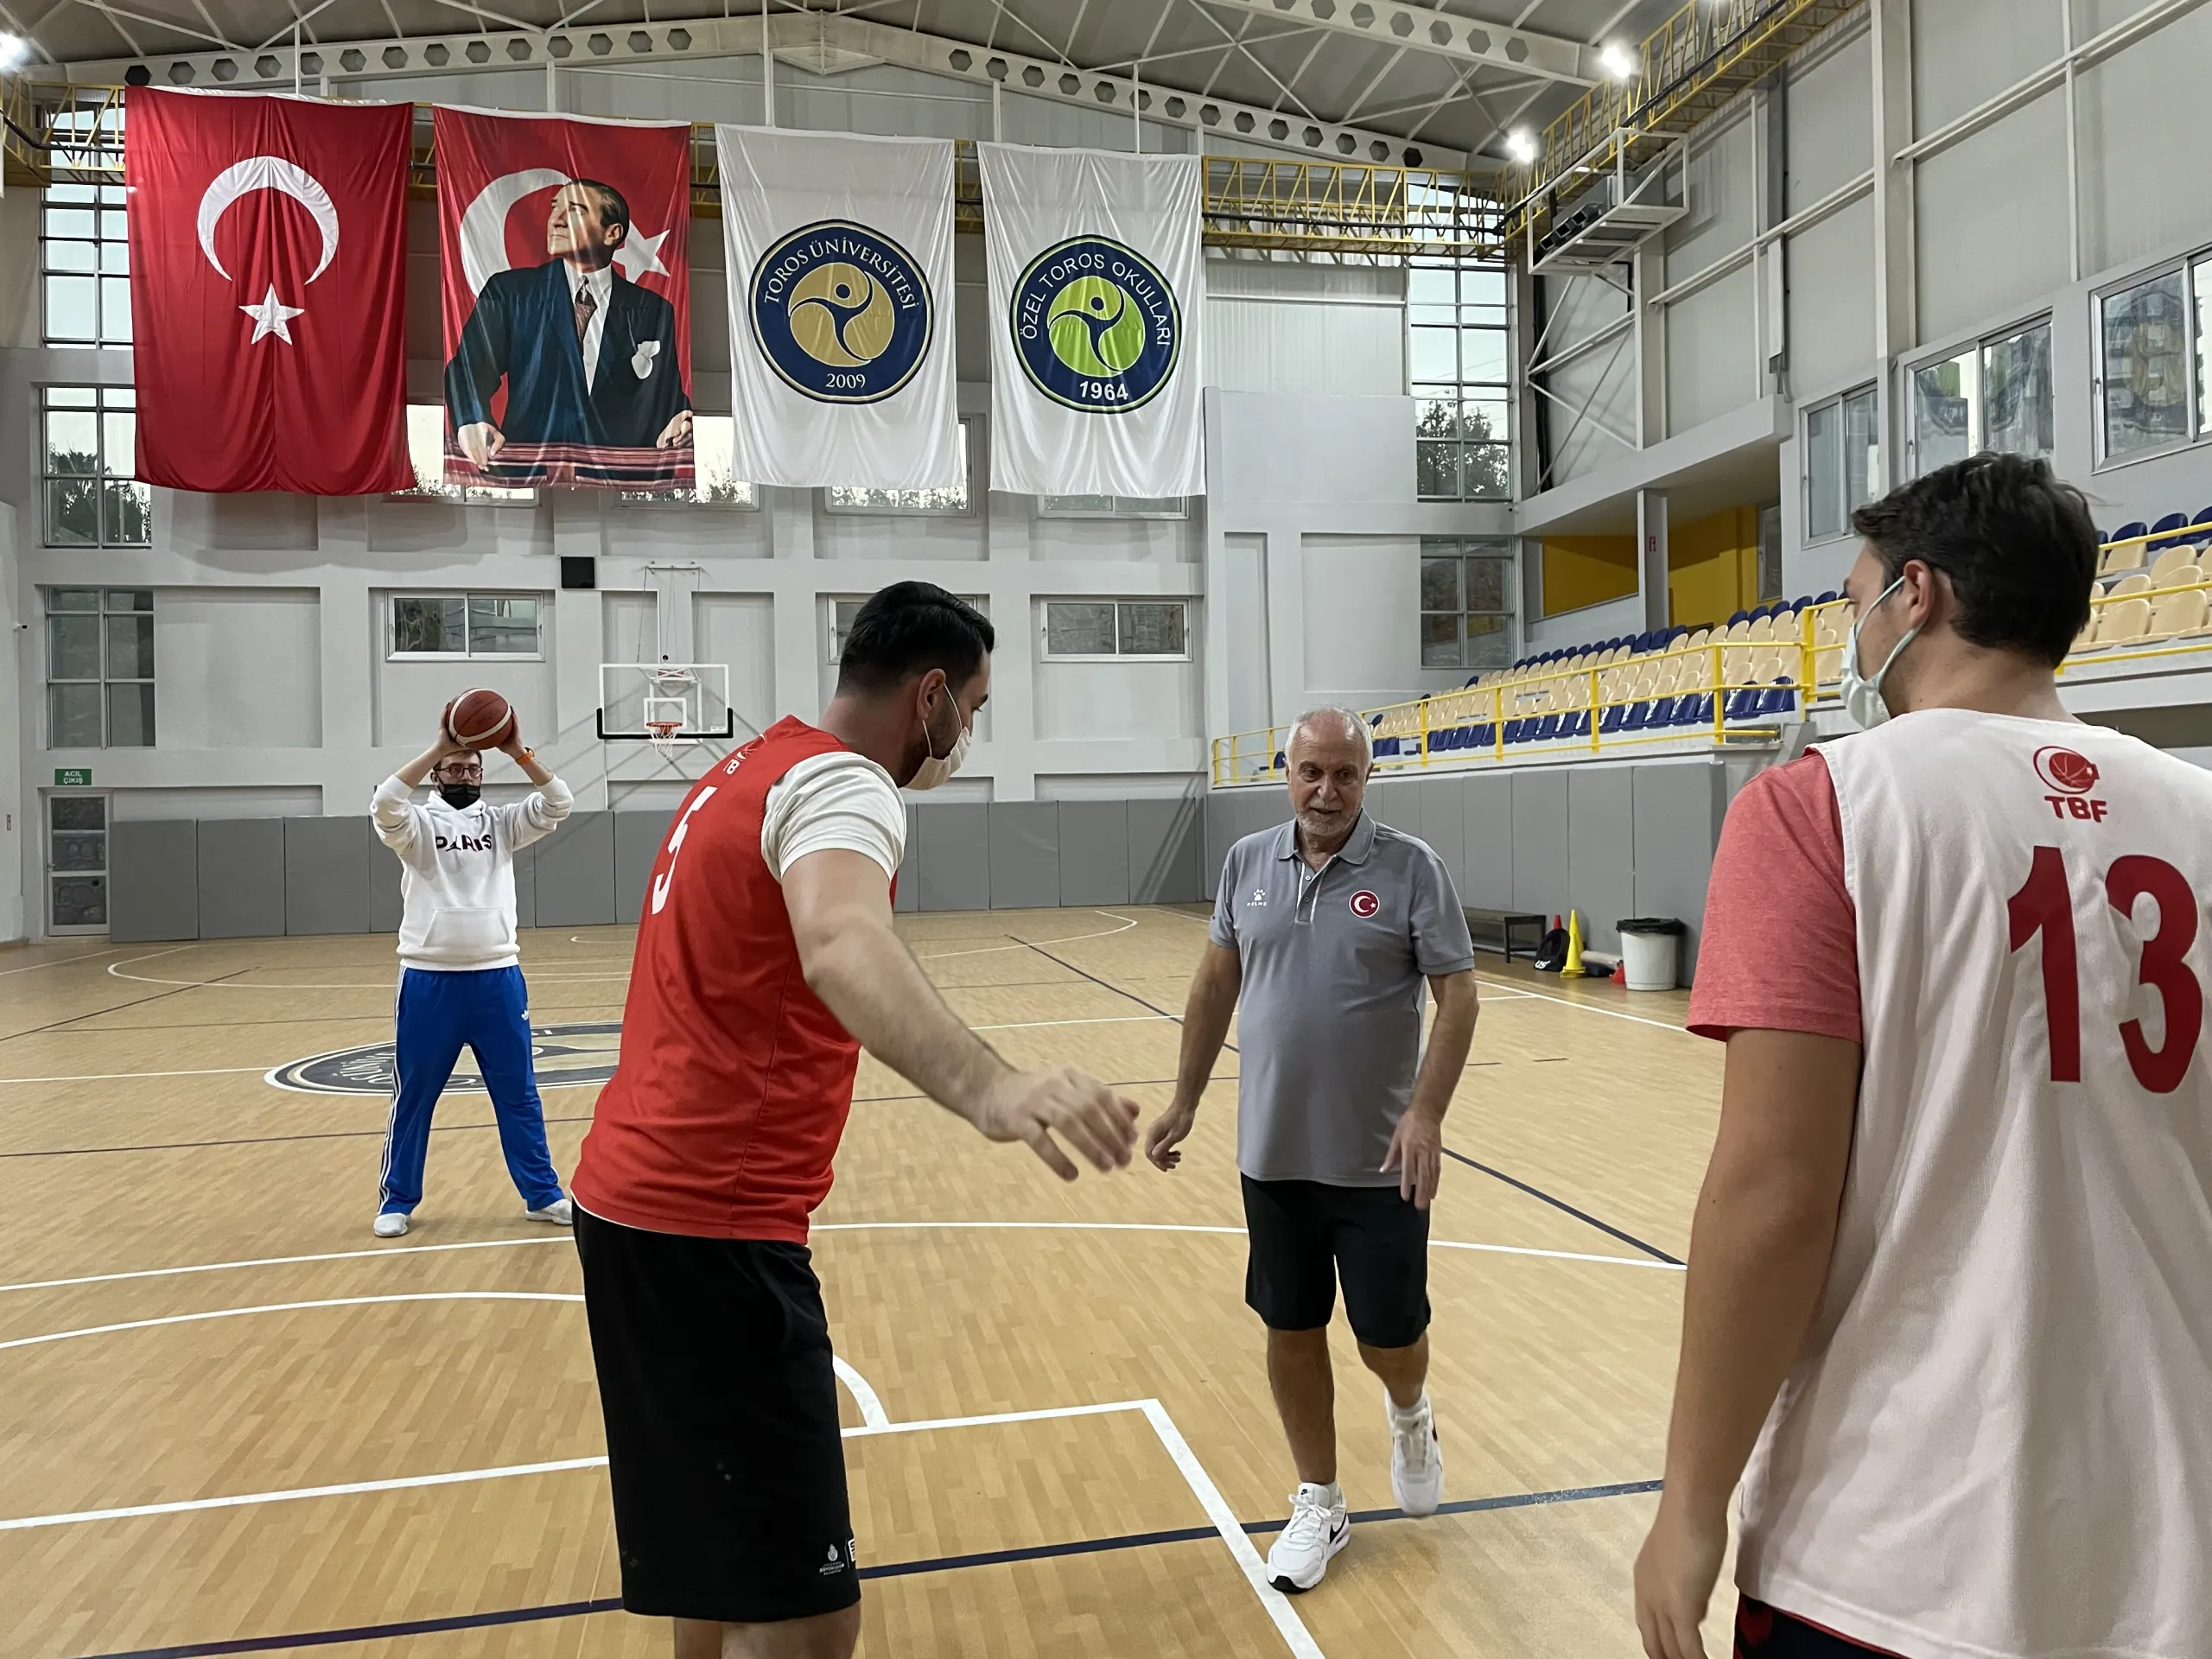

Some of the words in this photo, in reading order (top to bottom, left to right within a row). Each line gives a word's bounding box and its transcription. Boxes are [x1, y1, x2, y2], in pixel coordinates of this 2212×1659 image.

[765, 250, 809, 303] TOROS
[809, 237, 919, 309] ÜNİVERSİTESİ
[1020, 293, 1046, 339] ÖZEL
[1039, 253, 1105, 288] TOROS
[1112, 262, 1170, 346] OKULLARI
[825, 373, 866, 388] 2009
[1080, 380, 1128, 400] 1964
[2044, 795, 2107, 823] TBF
[2007, 845, 2202, 1093] 13
